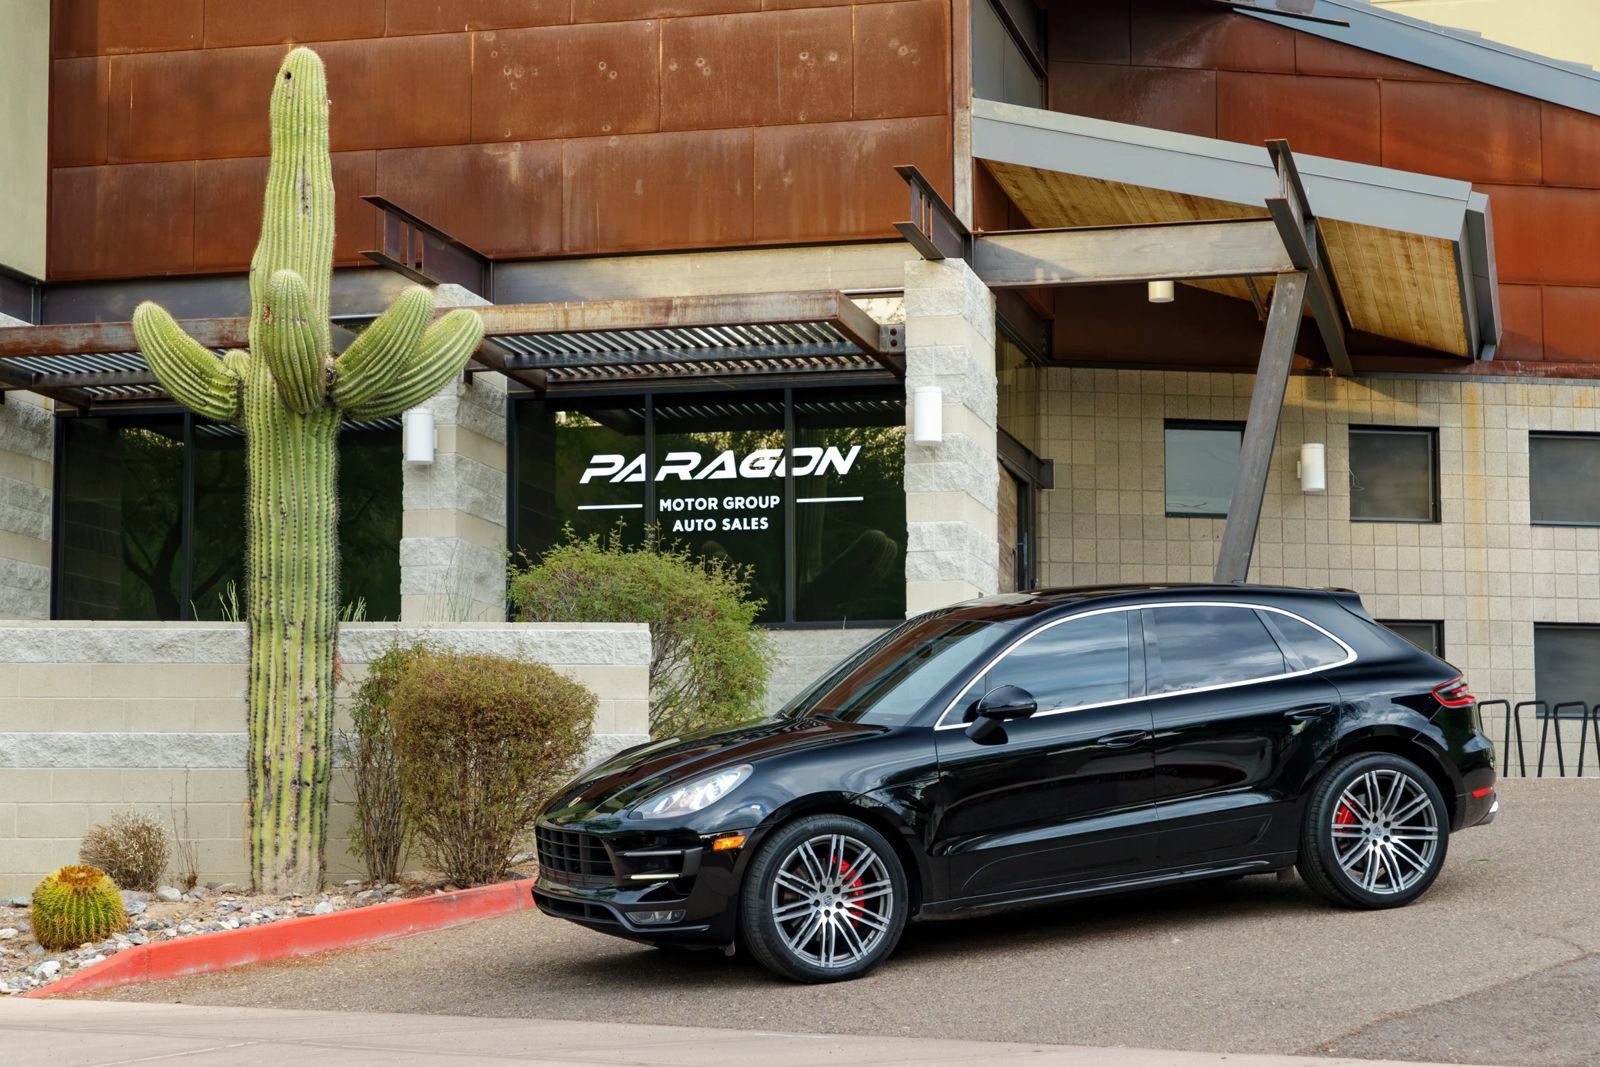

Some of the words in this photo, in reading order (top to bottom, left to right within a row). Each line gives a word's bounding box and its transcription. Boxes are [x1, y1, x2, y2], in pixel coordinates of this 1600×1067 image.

[579, 445, 862, 484] PARAGON
[659, 497, 718, 512] MOTOR
[722, 495, 780, 511] GROUP
[672, 518, 717, 532] AUTO
[722, 516, 769, 531] SALES
